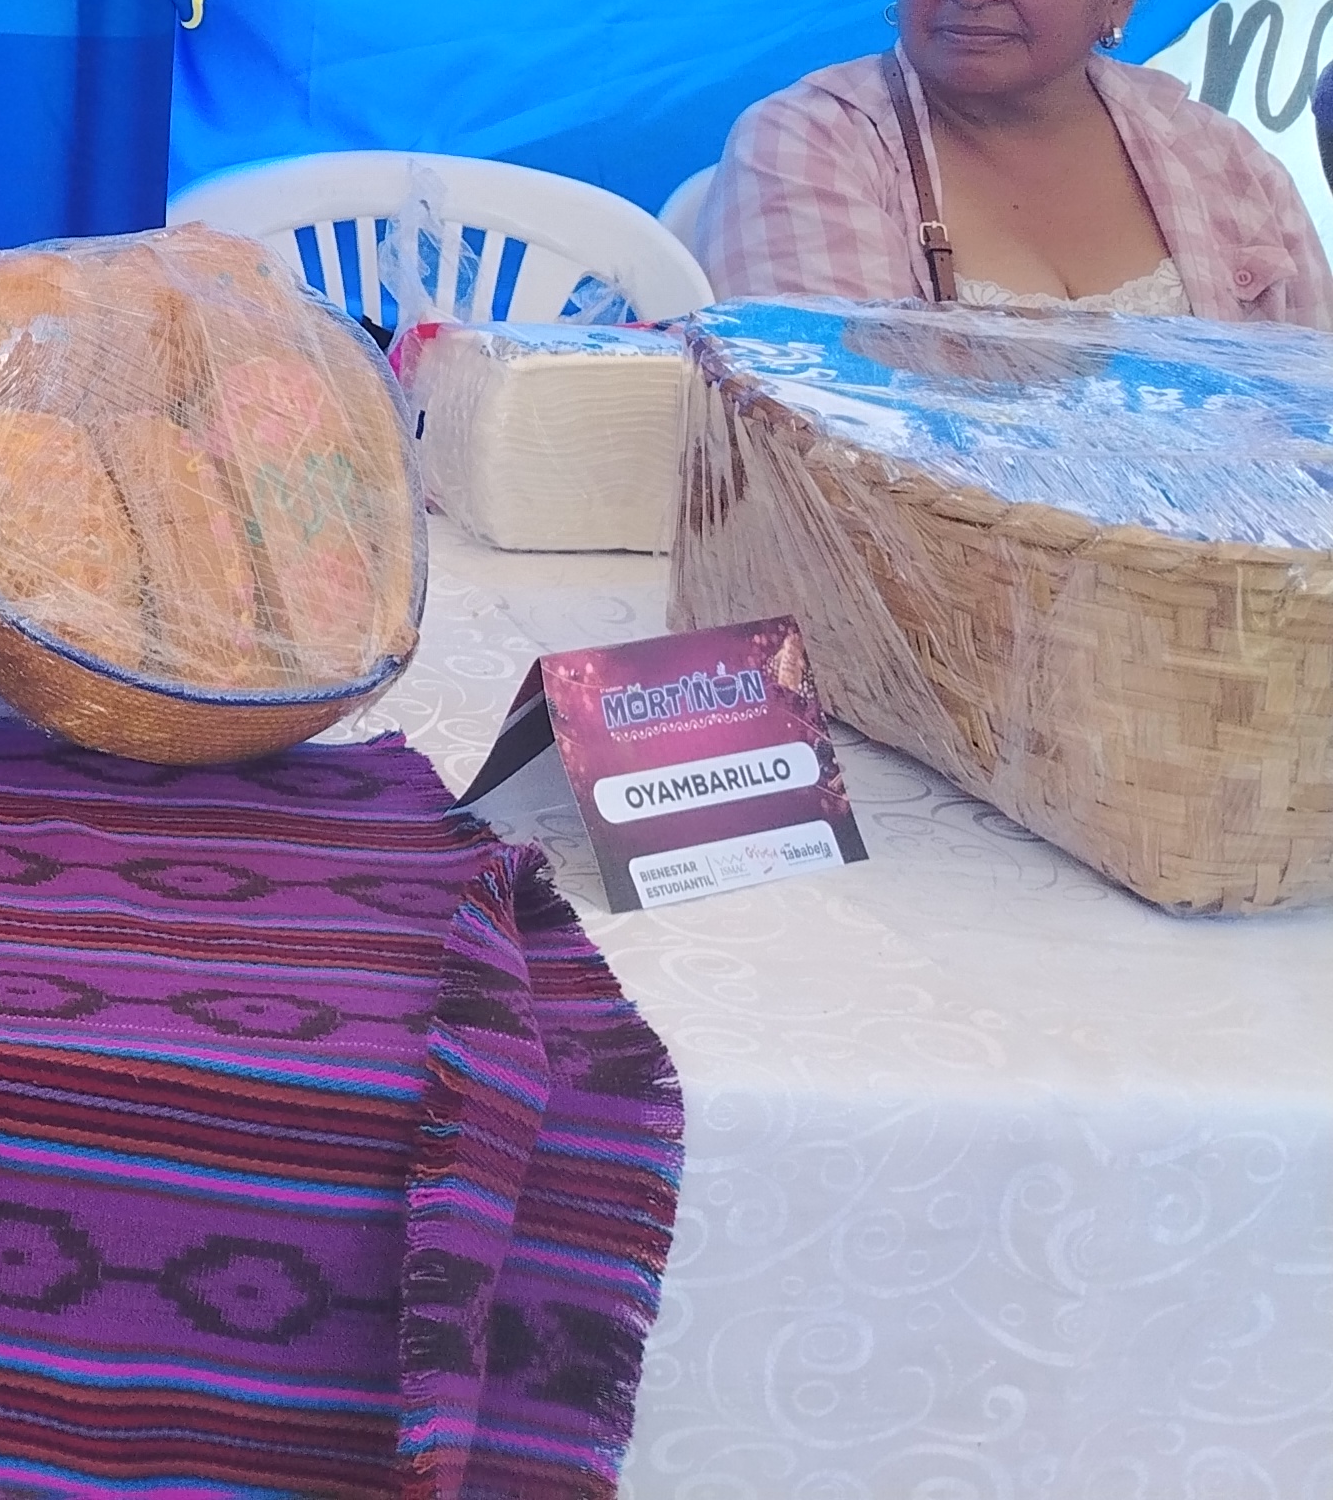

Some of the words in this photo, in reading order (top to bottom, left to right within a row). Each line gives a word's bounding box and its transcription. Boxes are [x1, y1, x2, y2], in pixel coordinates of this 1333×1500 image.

[625, 757, 791, 809] OYAMBARILLO
[639, 860, 699, 883] BIENESTAR
[646, 874, 715, 899] ESTUDIANTIL
